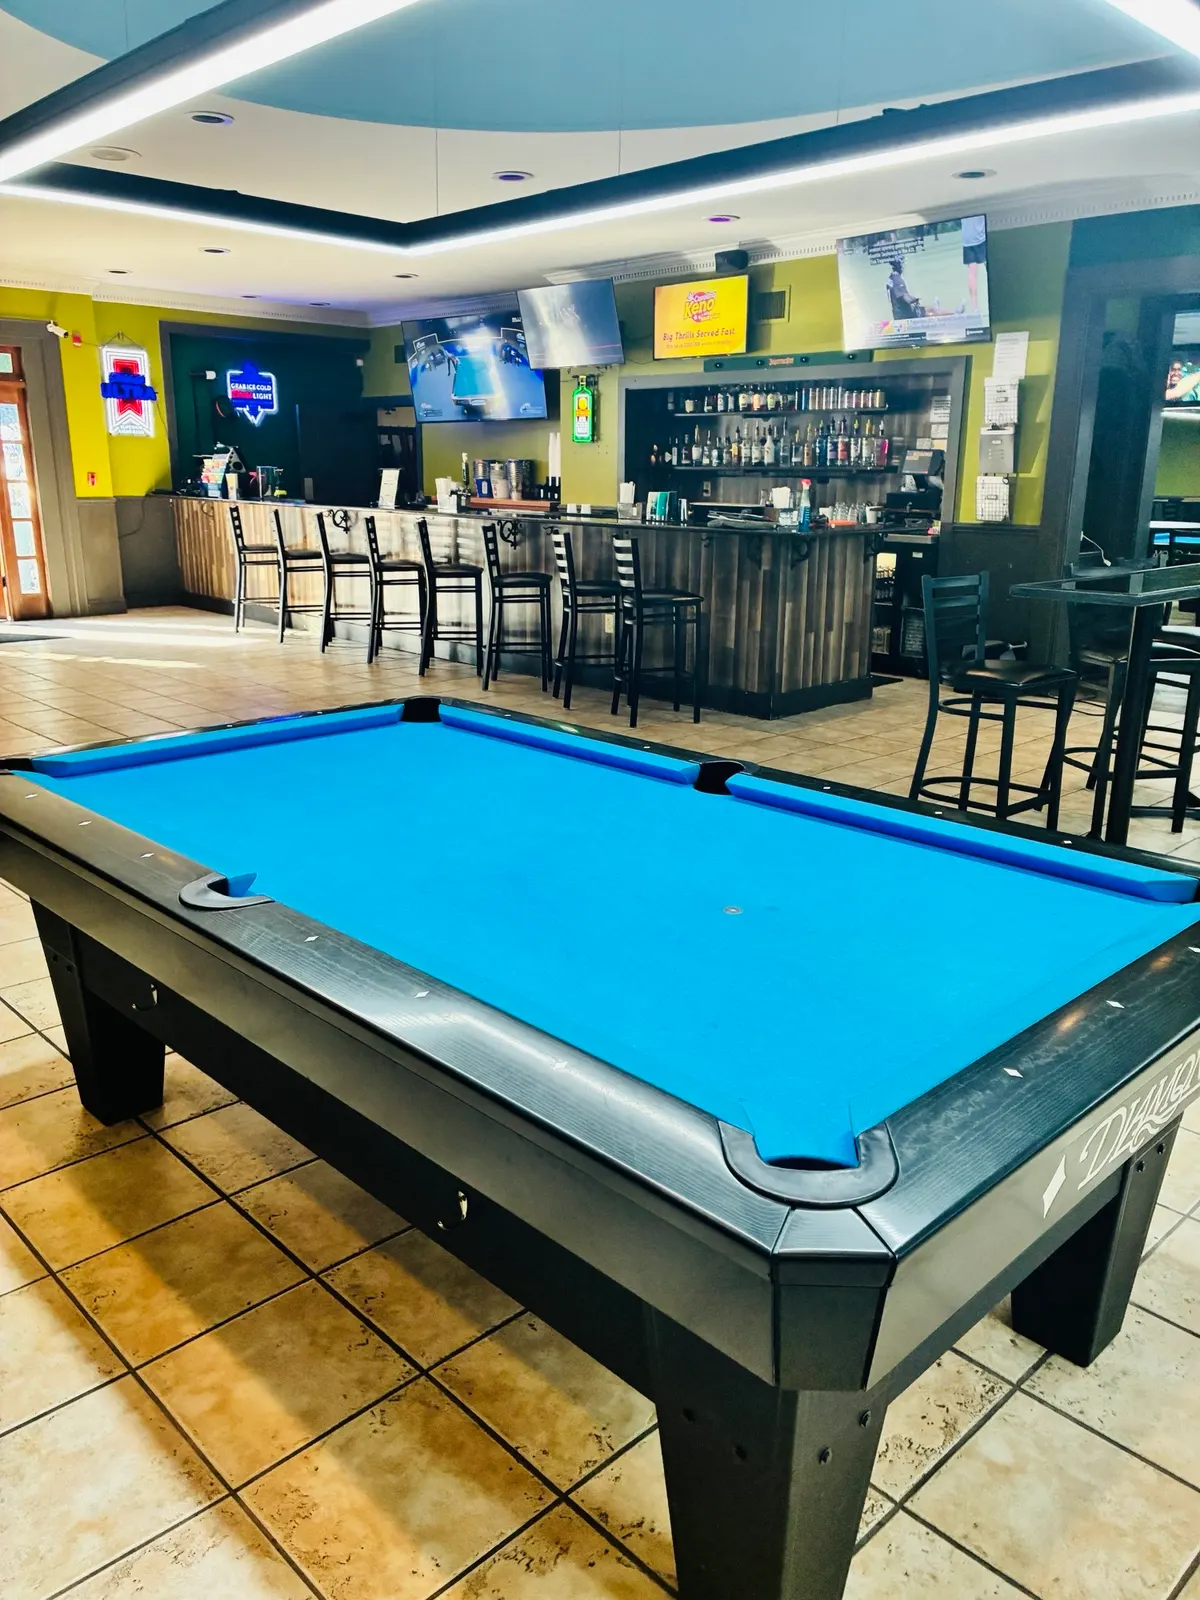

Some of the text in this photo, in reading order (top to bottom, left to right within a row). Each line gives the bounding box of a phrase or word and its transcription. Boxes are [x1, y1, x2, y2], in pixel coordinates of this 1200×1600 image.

[683, 297, 716, 320] Keno
[663, 332, 673, 343] Big
[675, 331, 695, 340] Thrills
[696, 329, 720, 338] Served
[100, 382, 157, 401] ULTRA
[230, 382, 246, 390] GRAB
[246, 383, 256, 391] ICE
[252, 392, 273, 401] LIGHT
[1077, 1050, 1200, 1191] DIAMO
